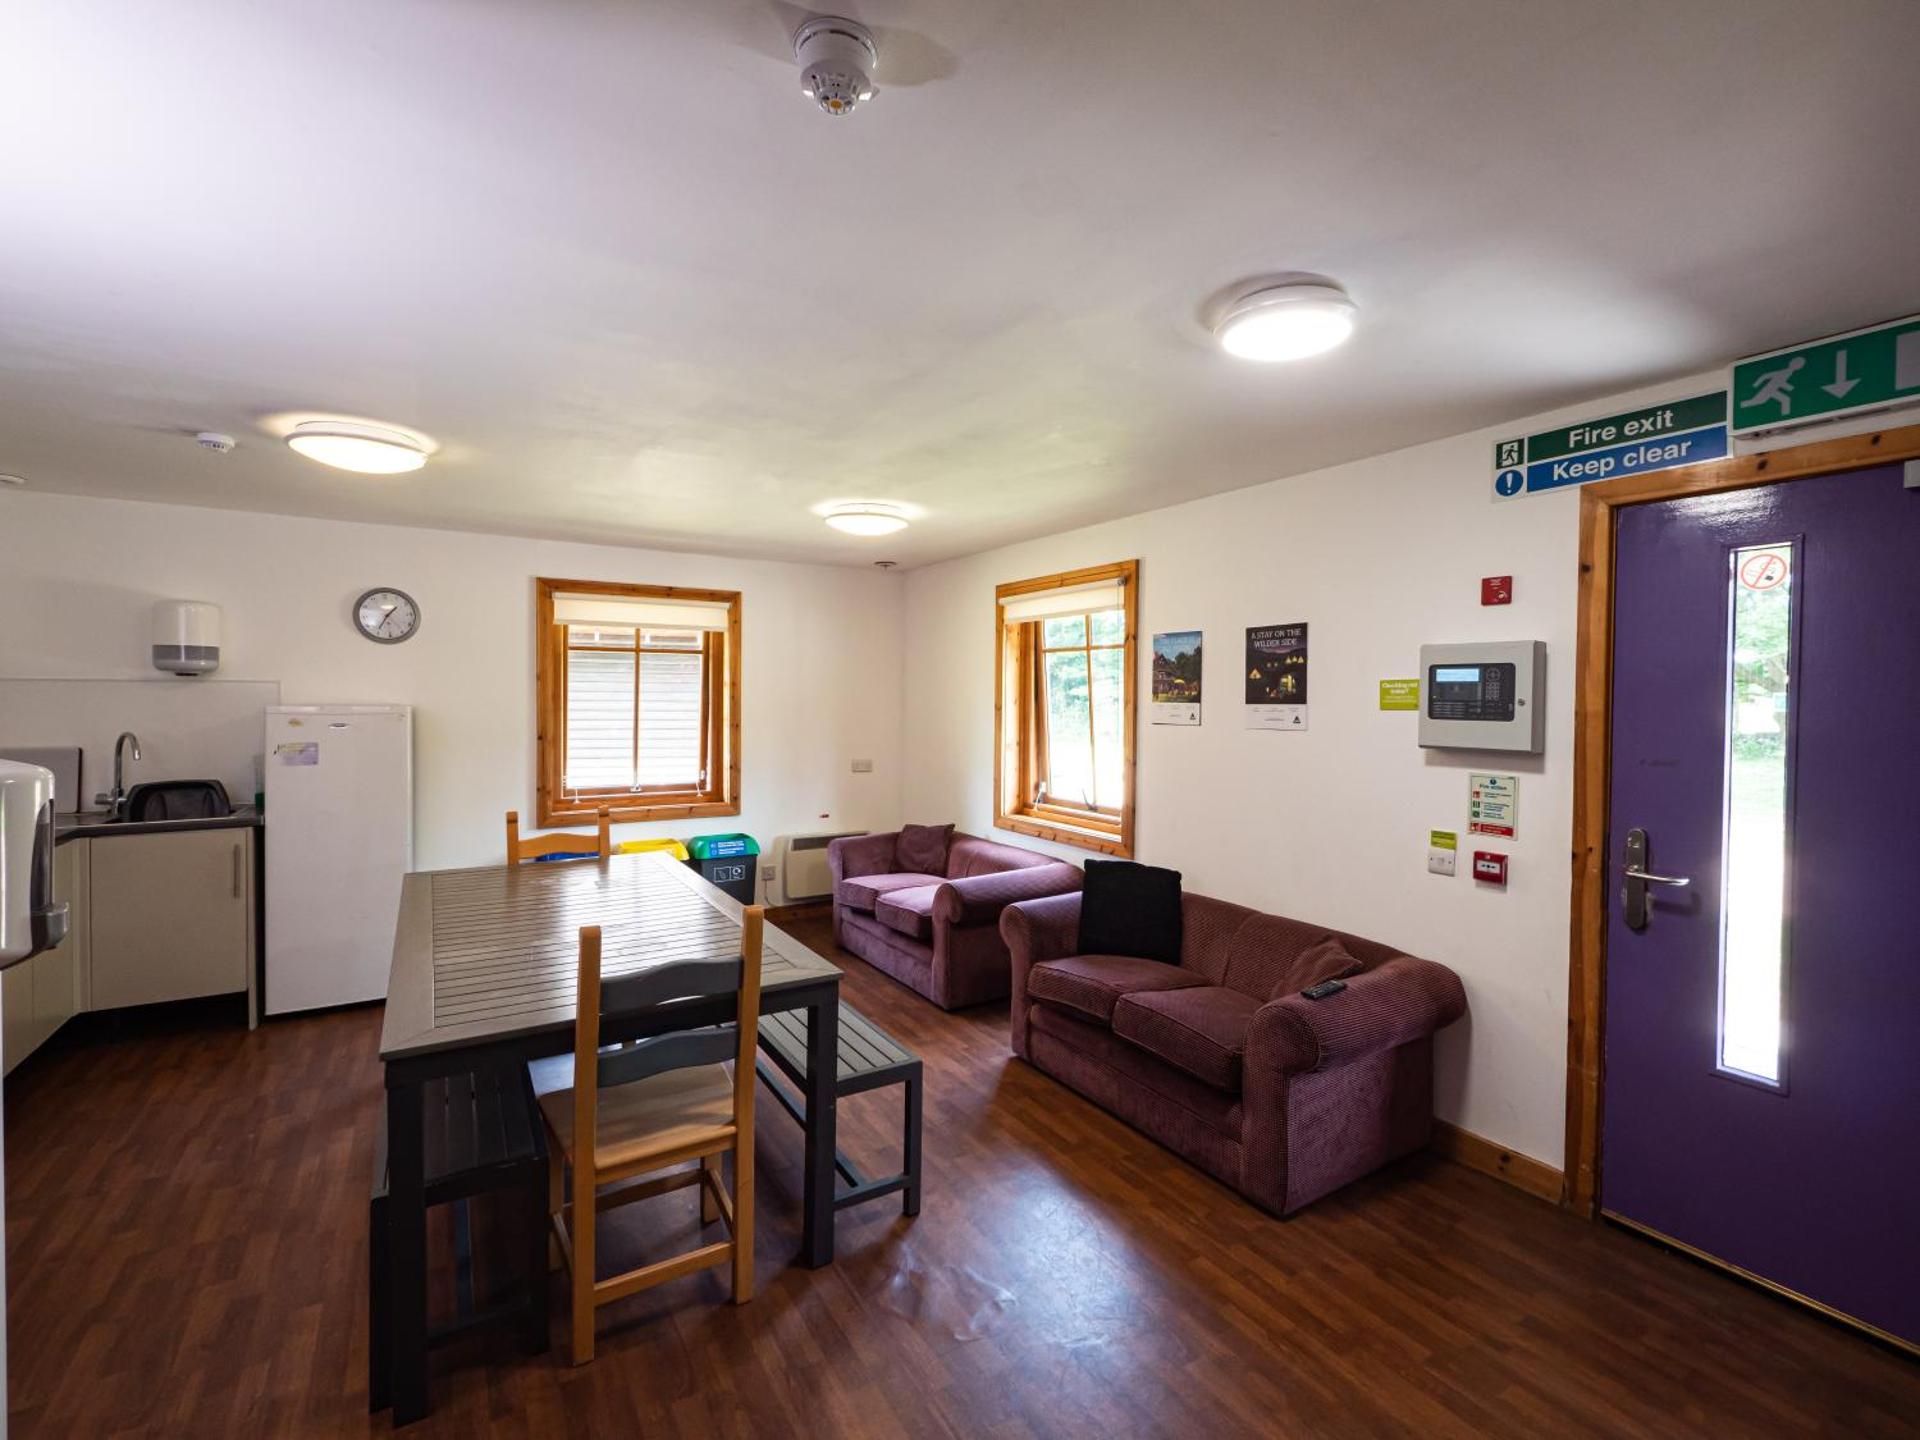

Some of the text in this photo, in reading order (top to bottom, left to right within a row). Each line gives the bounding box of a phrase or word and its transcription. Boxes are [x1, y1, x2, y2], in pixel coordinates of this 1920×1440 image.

[1568, 410, 1674, 449] Fire exit
[1553, 440, 1692, 481] Keep clear
[1256, 630, 1273, 639] STAY
[1274, 630, 1285, 638] ON
[1286, 628, 1302, 637] THE
